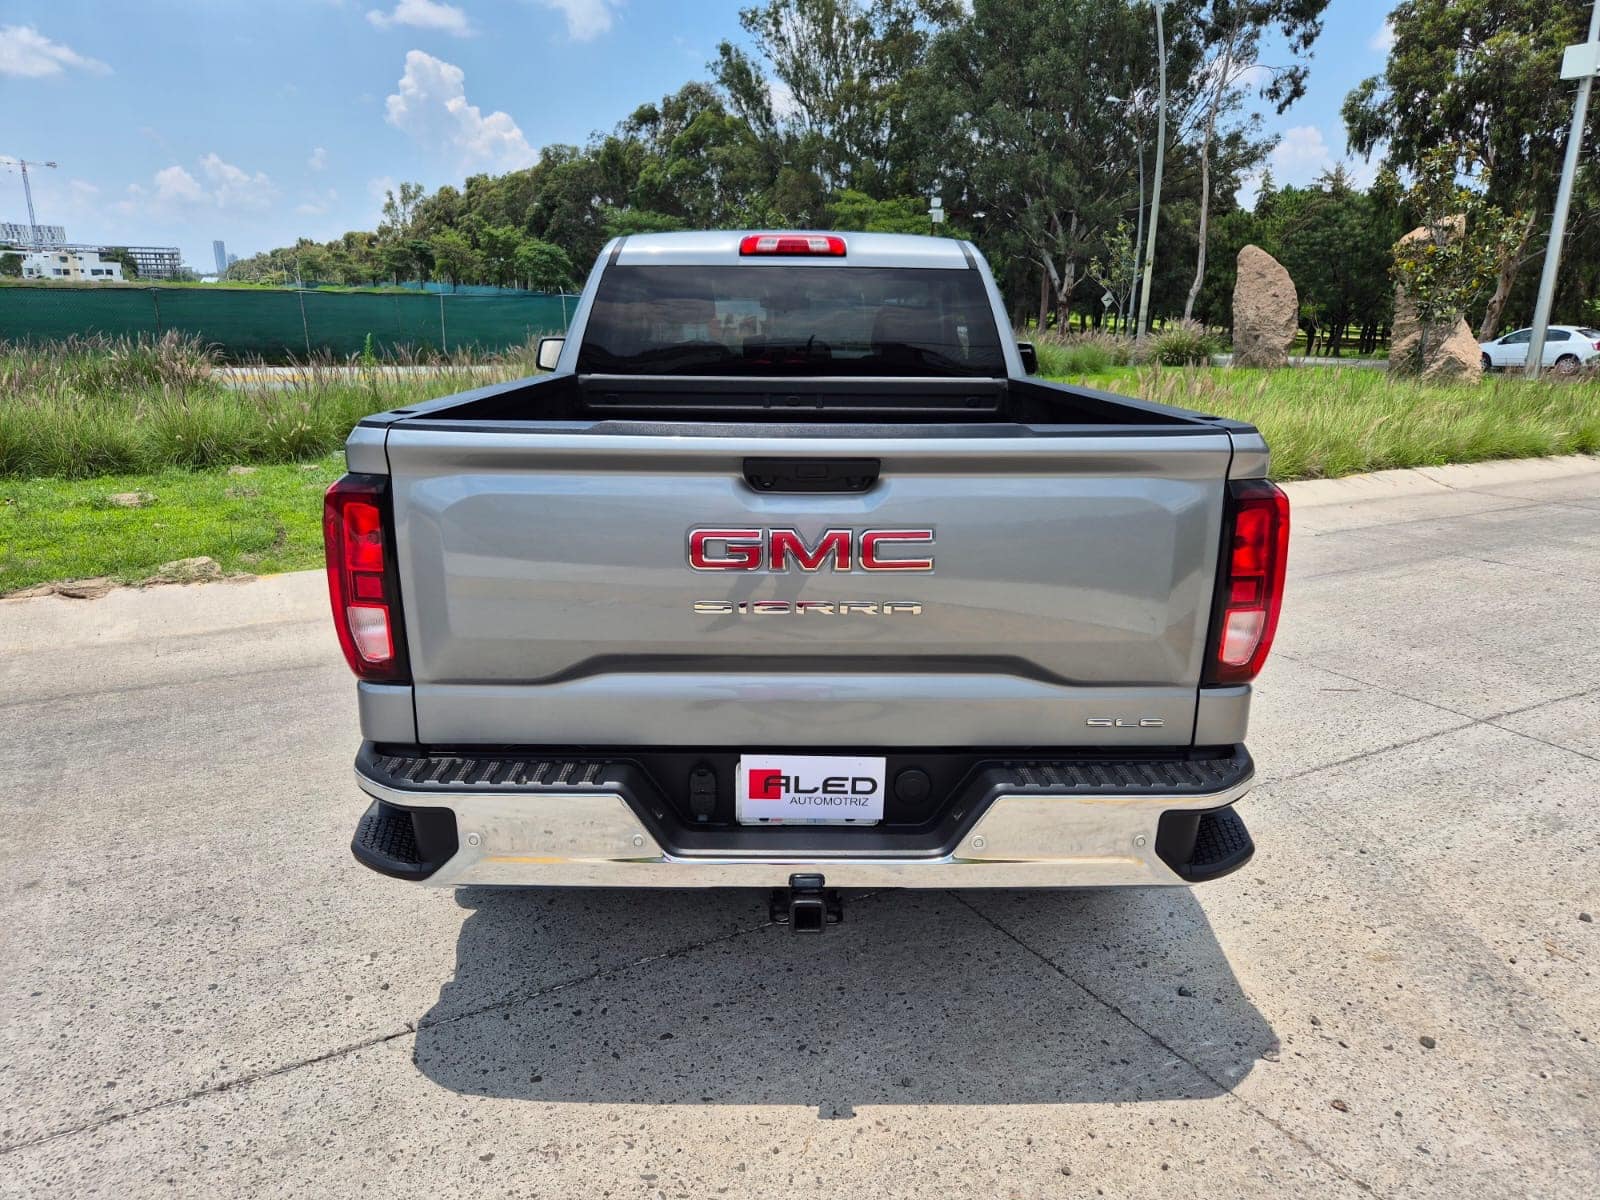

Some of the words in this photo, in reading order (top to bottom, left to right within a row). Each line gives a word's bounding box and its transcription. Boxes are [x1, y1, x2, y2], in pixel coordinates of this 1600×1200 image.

[688, 528, 934, 571] GMC
[693, 601, 923, 615] SIERRA
[764, 775, 878, 795] ALED
[790, 796, 869, 807] AUTOMOTRIZ
